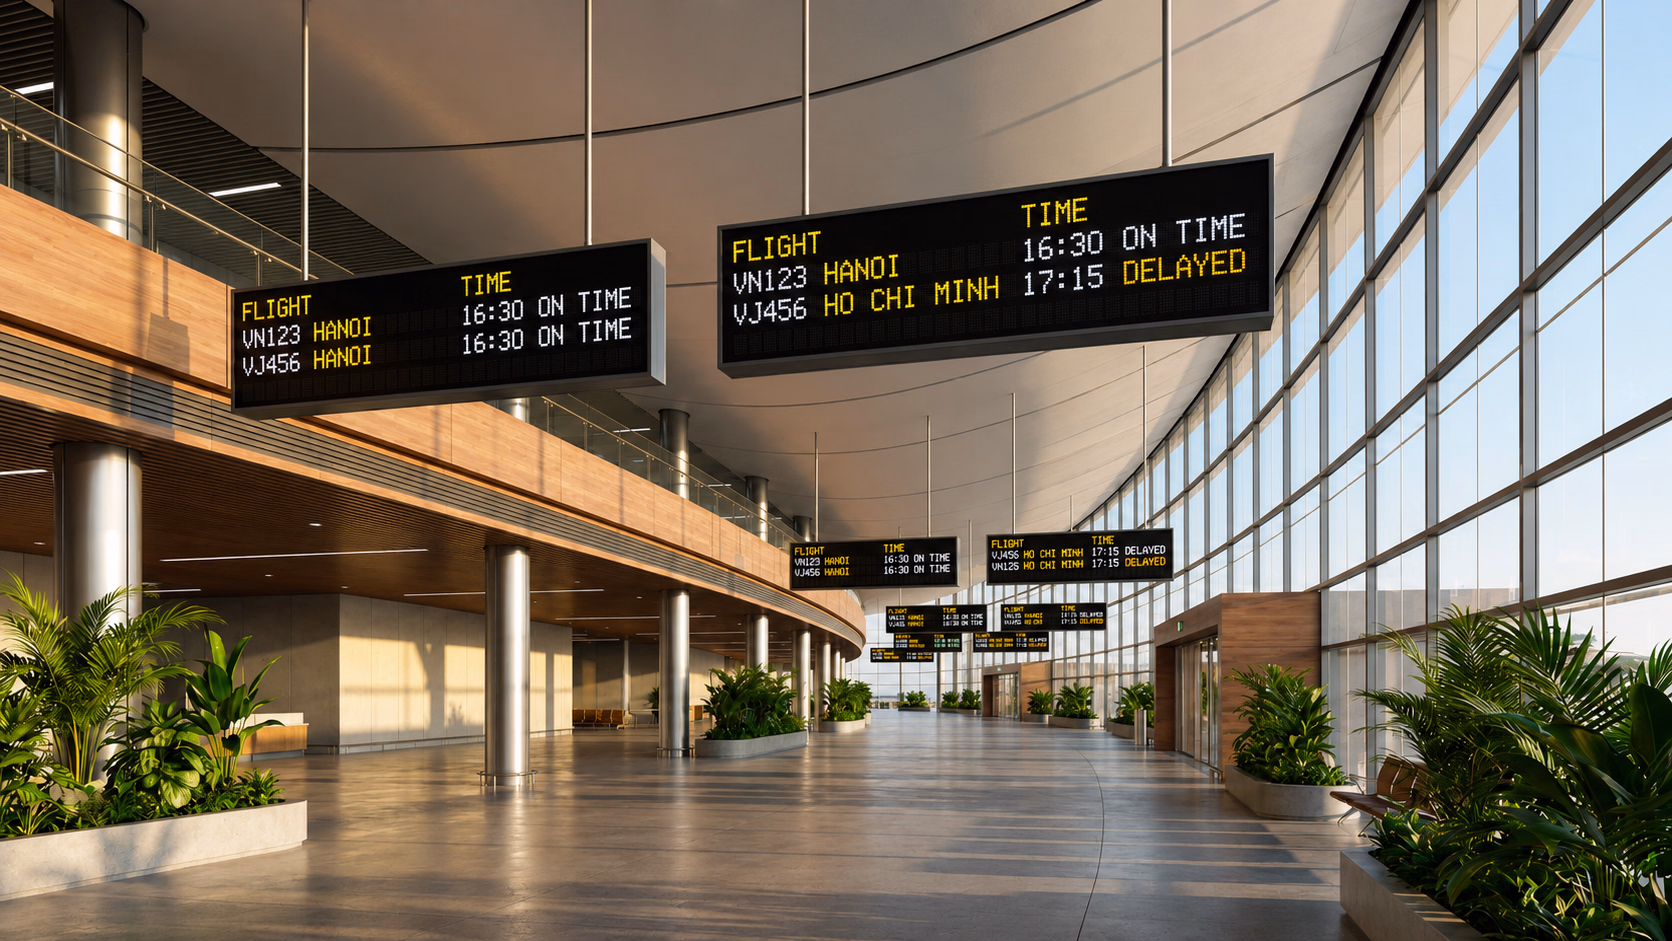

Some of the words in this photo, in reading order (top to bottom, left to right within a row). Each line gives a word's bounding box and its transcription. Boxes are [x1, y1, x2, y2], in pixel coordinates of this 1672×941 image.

[733, 231, 821, 263] FLIGHT
[1021, 197, 1087, 227] TIME
[734, 266, 806, 294] VN123
[824, 254, 898, 285] HANOI
[1025, 230, 1102, 262] 16:30
[1123, 224, 1156, 250] ON
[1176, 213, 1245, 244] TIME
[243, 295, 311, 321] FLIGHT
[461, 271, 511, 296] TIME
[734, 297, 806, 325] VJ456
[825, 292, 853, 316] HO
[871, 285, 914, 311] CHI
[935, 276, 998, 305] MINH
[1025, 264, 1103, 296] 17:15
[1123, 248, 1245, 285] DELAYED
[243, 325, 300, 349] VN123
[314, 316, 371, 342] HANOI
[463, 300, 523, 325] 16:30
[539, 294, 563, 317] ON
[578, 287, 631, 312] TIME
[243, 353, 300, 376] VJ456
[314, 345, 371, 369] HANOI
[464, 329, 523, 354] 16:30
[539, 324, 563, 347] ON
[579, 317, 631, 342] TIME
[795, 546, 824, 556] FLIGHT
[884, 543, 904, 553] TIME
[992, 539, 1024, 548] FLIGHT
[1092, 535, 1114, 545] TIME
[1024, 550, 1034, 559] HO
[1040, 549, 1055, 558] CHI
[1062, 548, 1083, 557] MINH
[1093, 547, 1119, 556] 17:15
[1125, 545, 1165, 555] DELAYED
[795, 557, 820, 566] VN123
[825, 556, 849, 565] HANOI
[885, 555, 909, 563] 16:30
[914, 554, 924, 562] ON
[929, 553, 950, 562] TIME
[795, 568, 820, 577] VJ456
[884, 566, 909, 574] 16:30
[914, 565, 924, 573] ON
[930, 564, 950, 573] TIME
[1024, 561, 1034, 570] HO
[1040, 561, 1055, 569] CHI
[1062, 560, 1083, 568] MINH
[1093, 558, 1119, 568] 17:15
[1125, 557, 1166, 567] DELAYED
